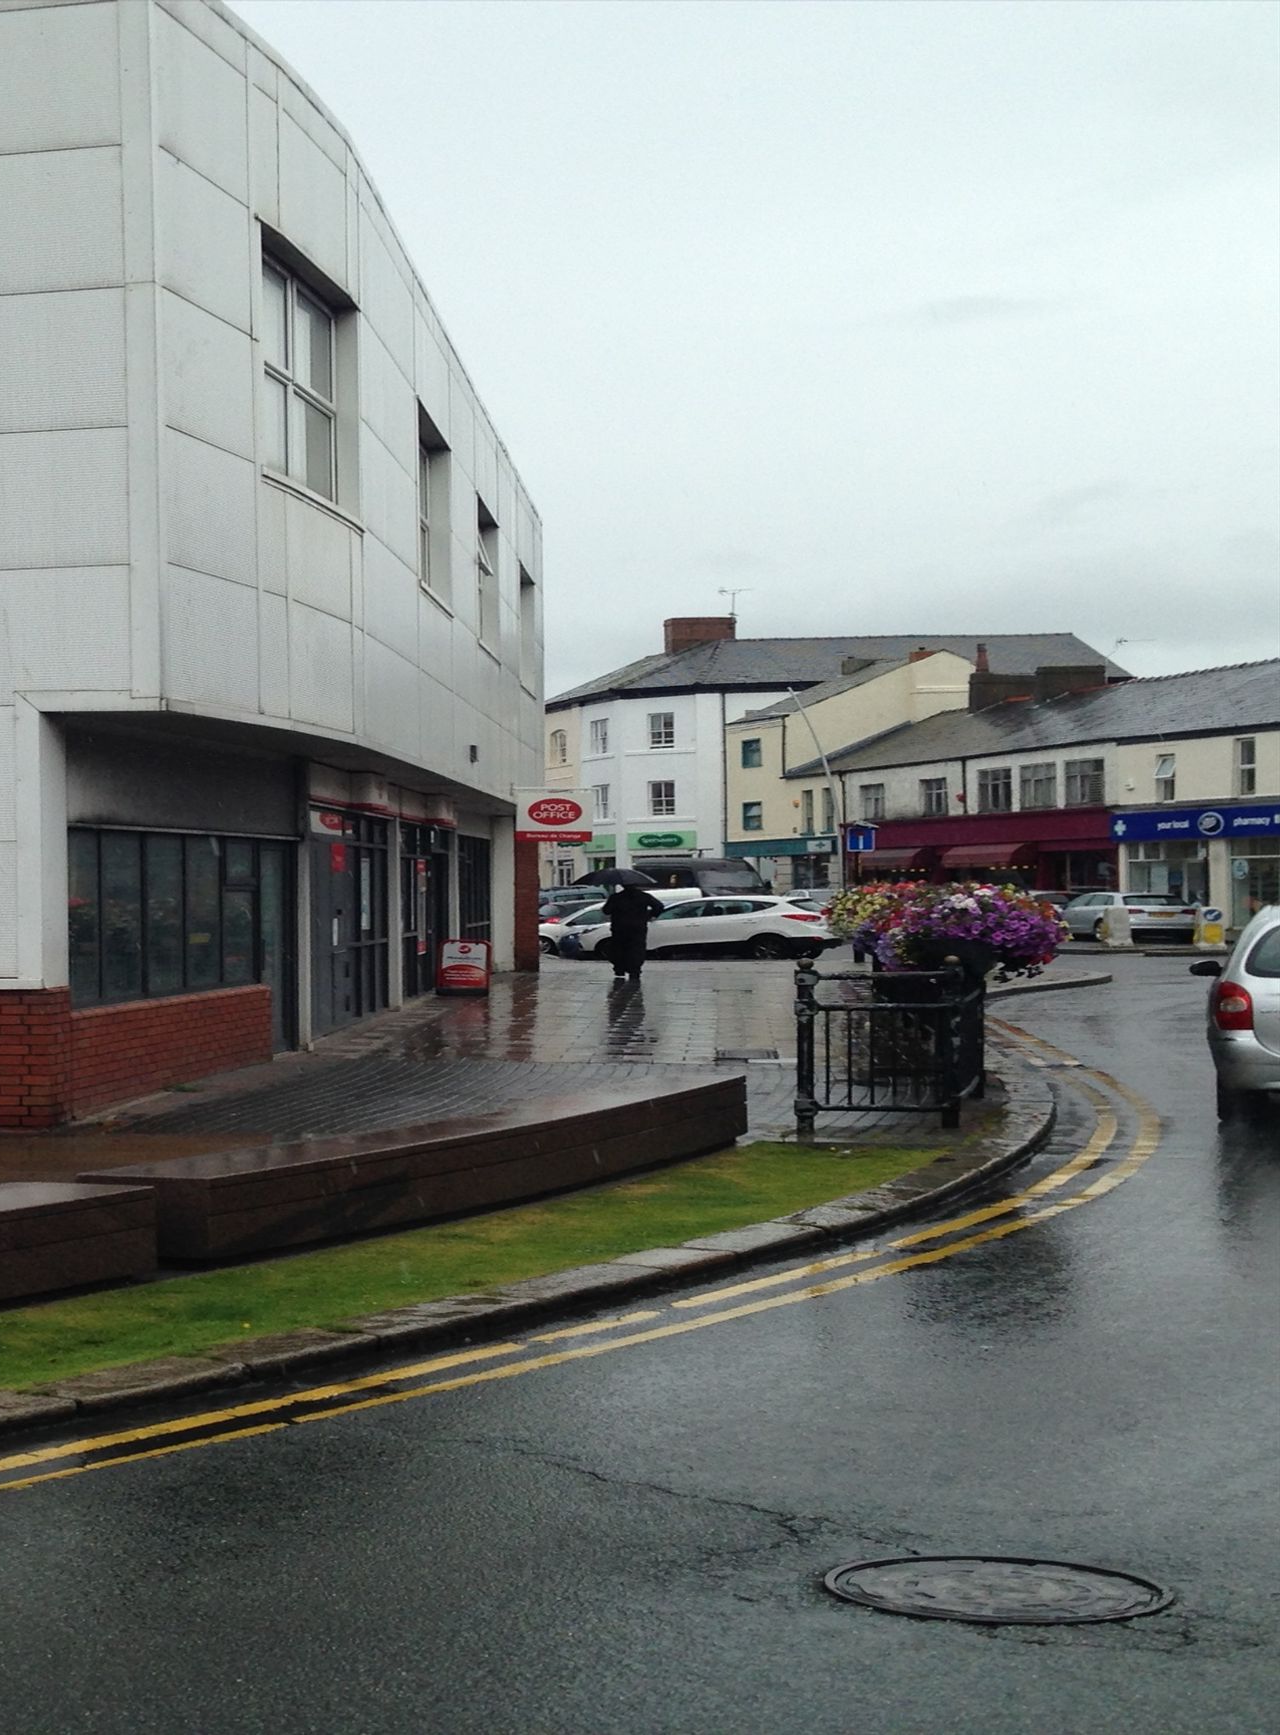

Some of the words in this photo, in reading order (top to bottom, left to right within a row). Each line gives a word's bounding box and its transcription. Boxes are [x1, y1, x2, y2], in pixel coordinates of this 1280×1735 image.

[540, 803, 573, 811] POST
[532, 811, 577, 819] OFFICE
[1157, 822, 1172, 831] your
[1233, 817, 1270, 826] pharmacy
